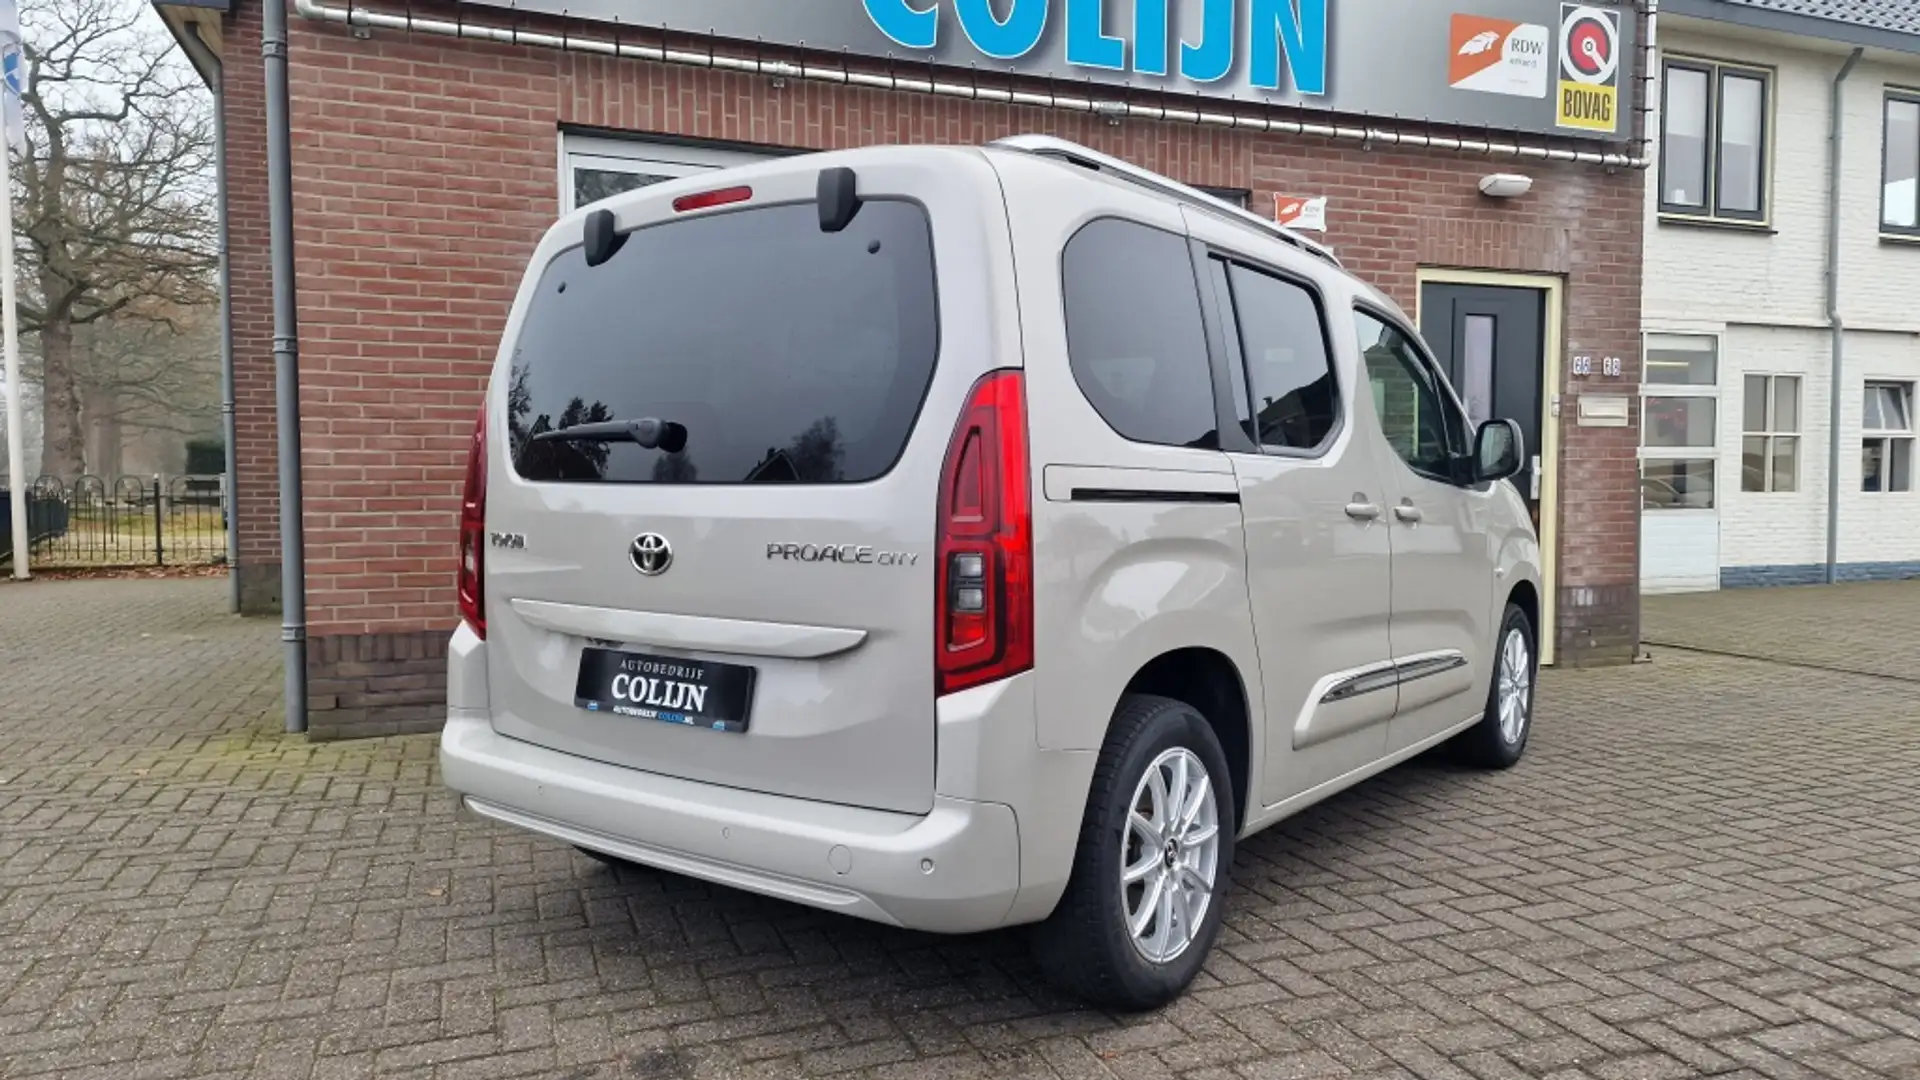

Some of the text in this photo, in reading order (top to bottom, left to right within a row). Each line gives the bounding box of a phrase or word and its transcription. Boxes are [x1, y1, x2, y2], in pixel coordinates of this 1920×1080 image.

[1511, 37, 1545, 56] RDW
[1562, 88, 1611, 122] BOVAG
[766, 542, 919, 566] PROACE CITY
[618, 659, 705, 680] AUTOBEDRIJF
[611, 673, 708, 713] COLIJN
